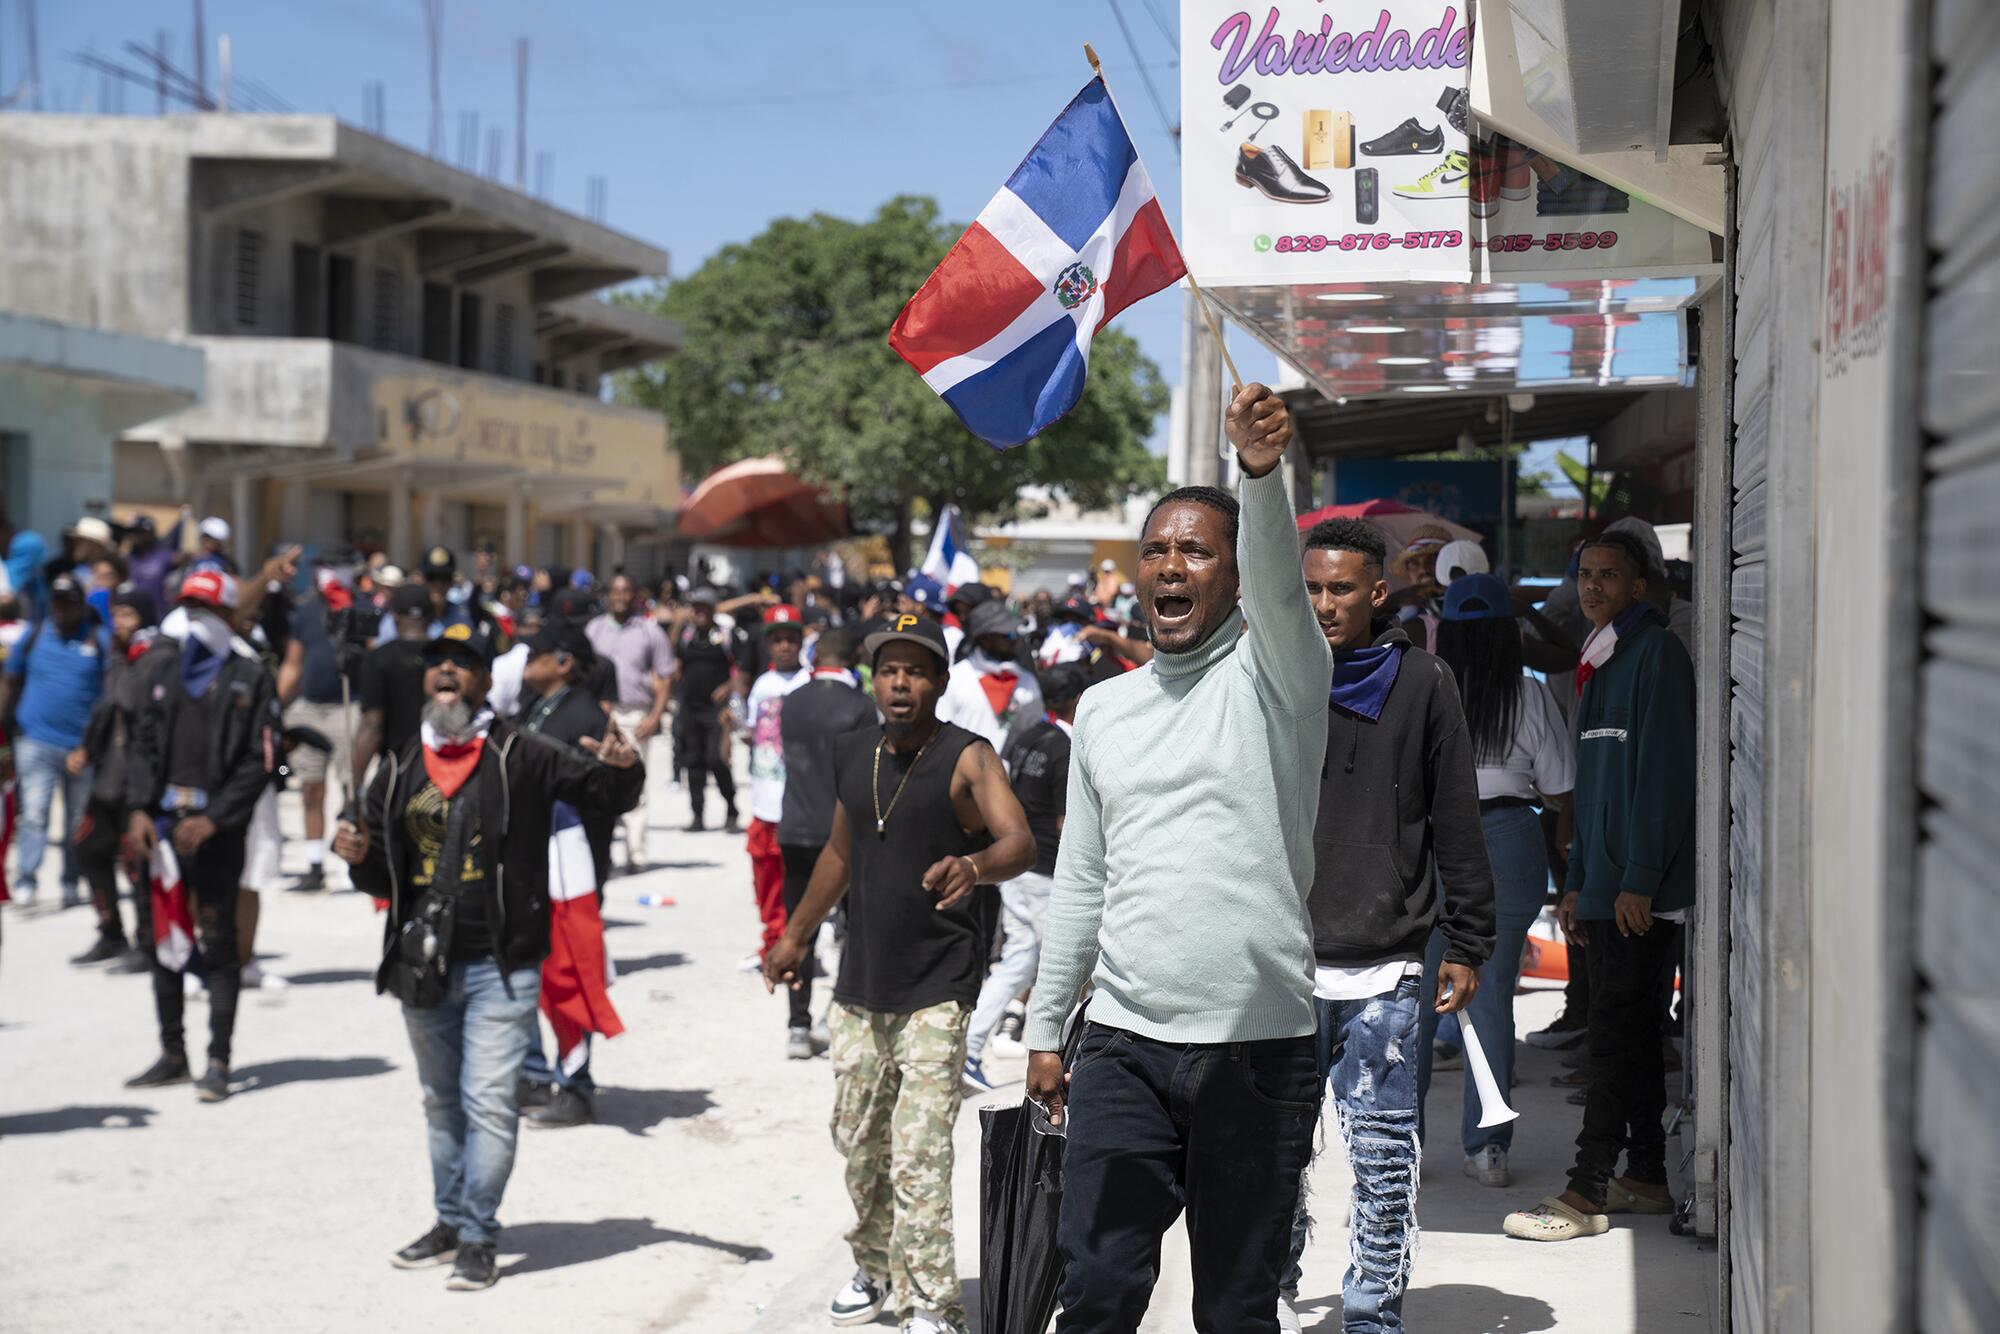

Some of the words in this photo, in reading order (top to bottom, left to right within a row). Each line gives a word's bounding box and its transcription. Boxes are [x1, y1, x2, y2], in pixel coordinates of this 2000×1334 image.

[1275, 231, 1463, 252] 829-876-5173
[1471, 230, 1618, 252] -615-5599
[896, 613, 918, 632] P
